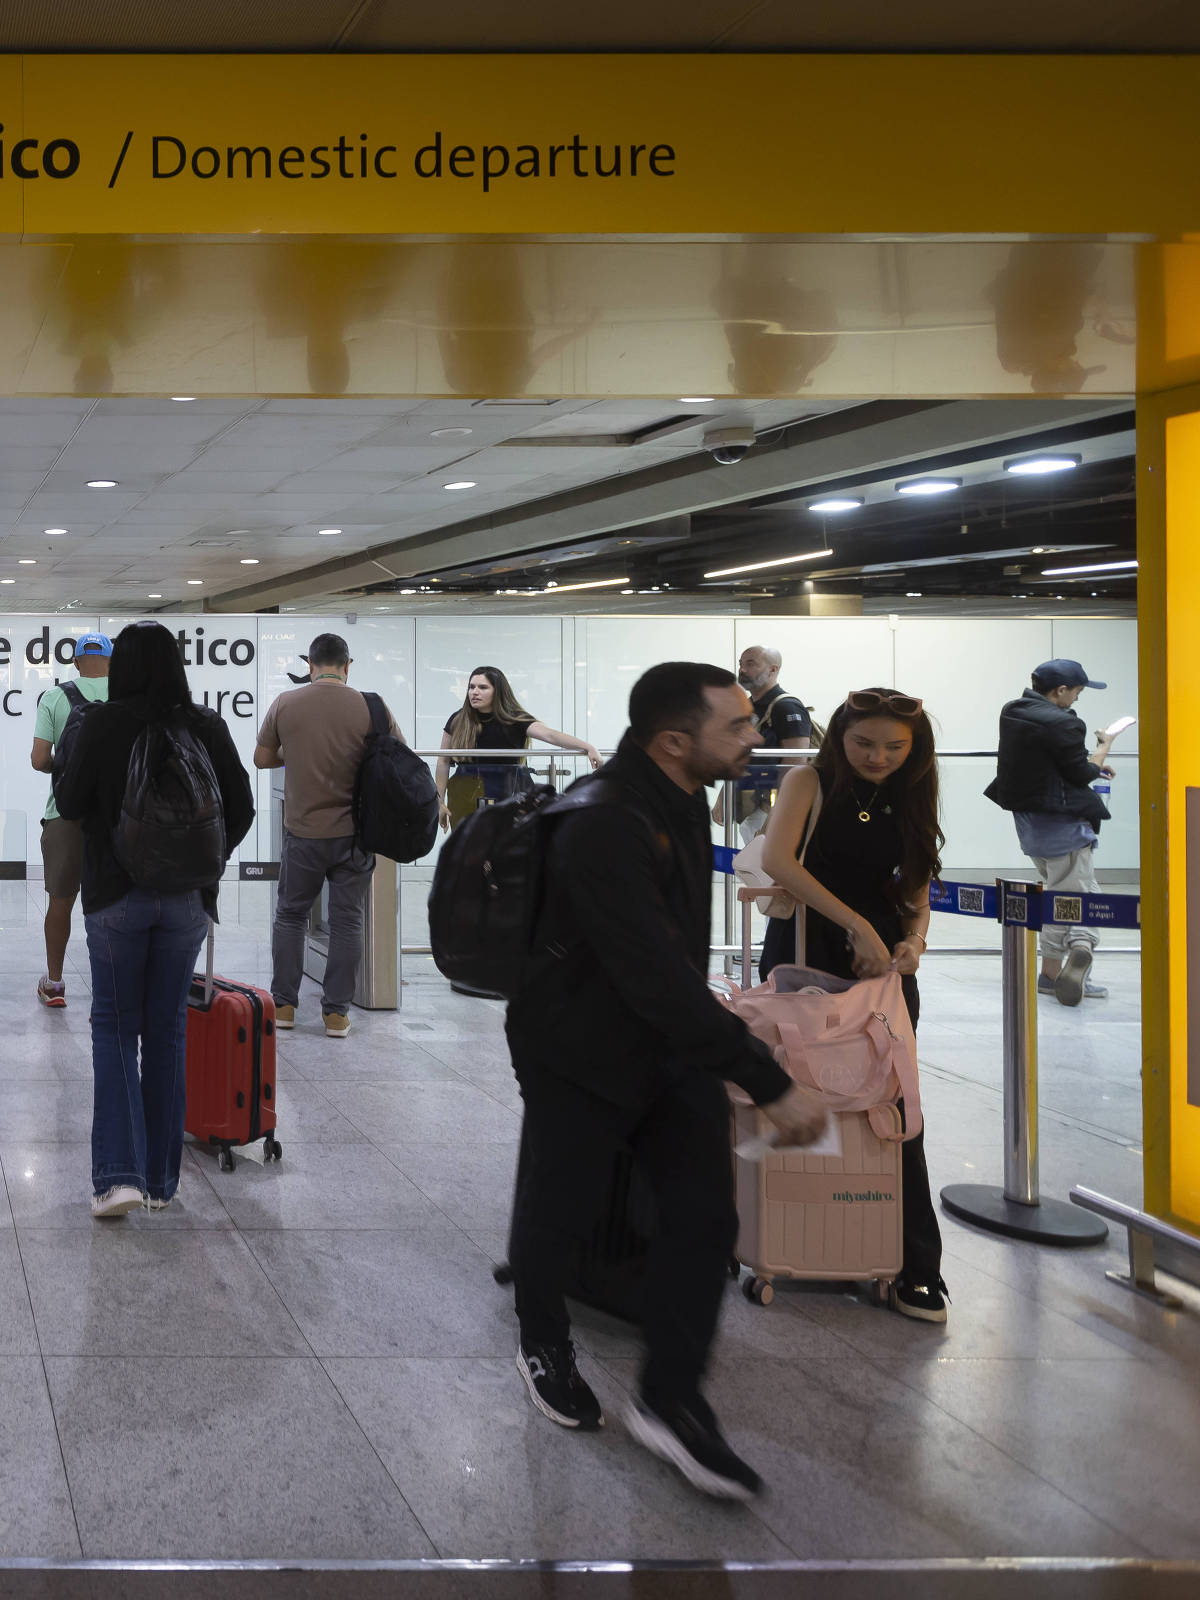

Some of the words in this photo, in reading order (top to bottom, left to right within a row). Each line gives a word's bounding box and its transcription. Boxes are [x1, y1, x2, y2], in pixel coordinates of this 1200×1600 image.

[108, 131, 134, 189] /
[152, 132, 398, 180] Domestic
[413, 131, 676, 193] departure
[25, 625, 255, 666] dotico
